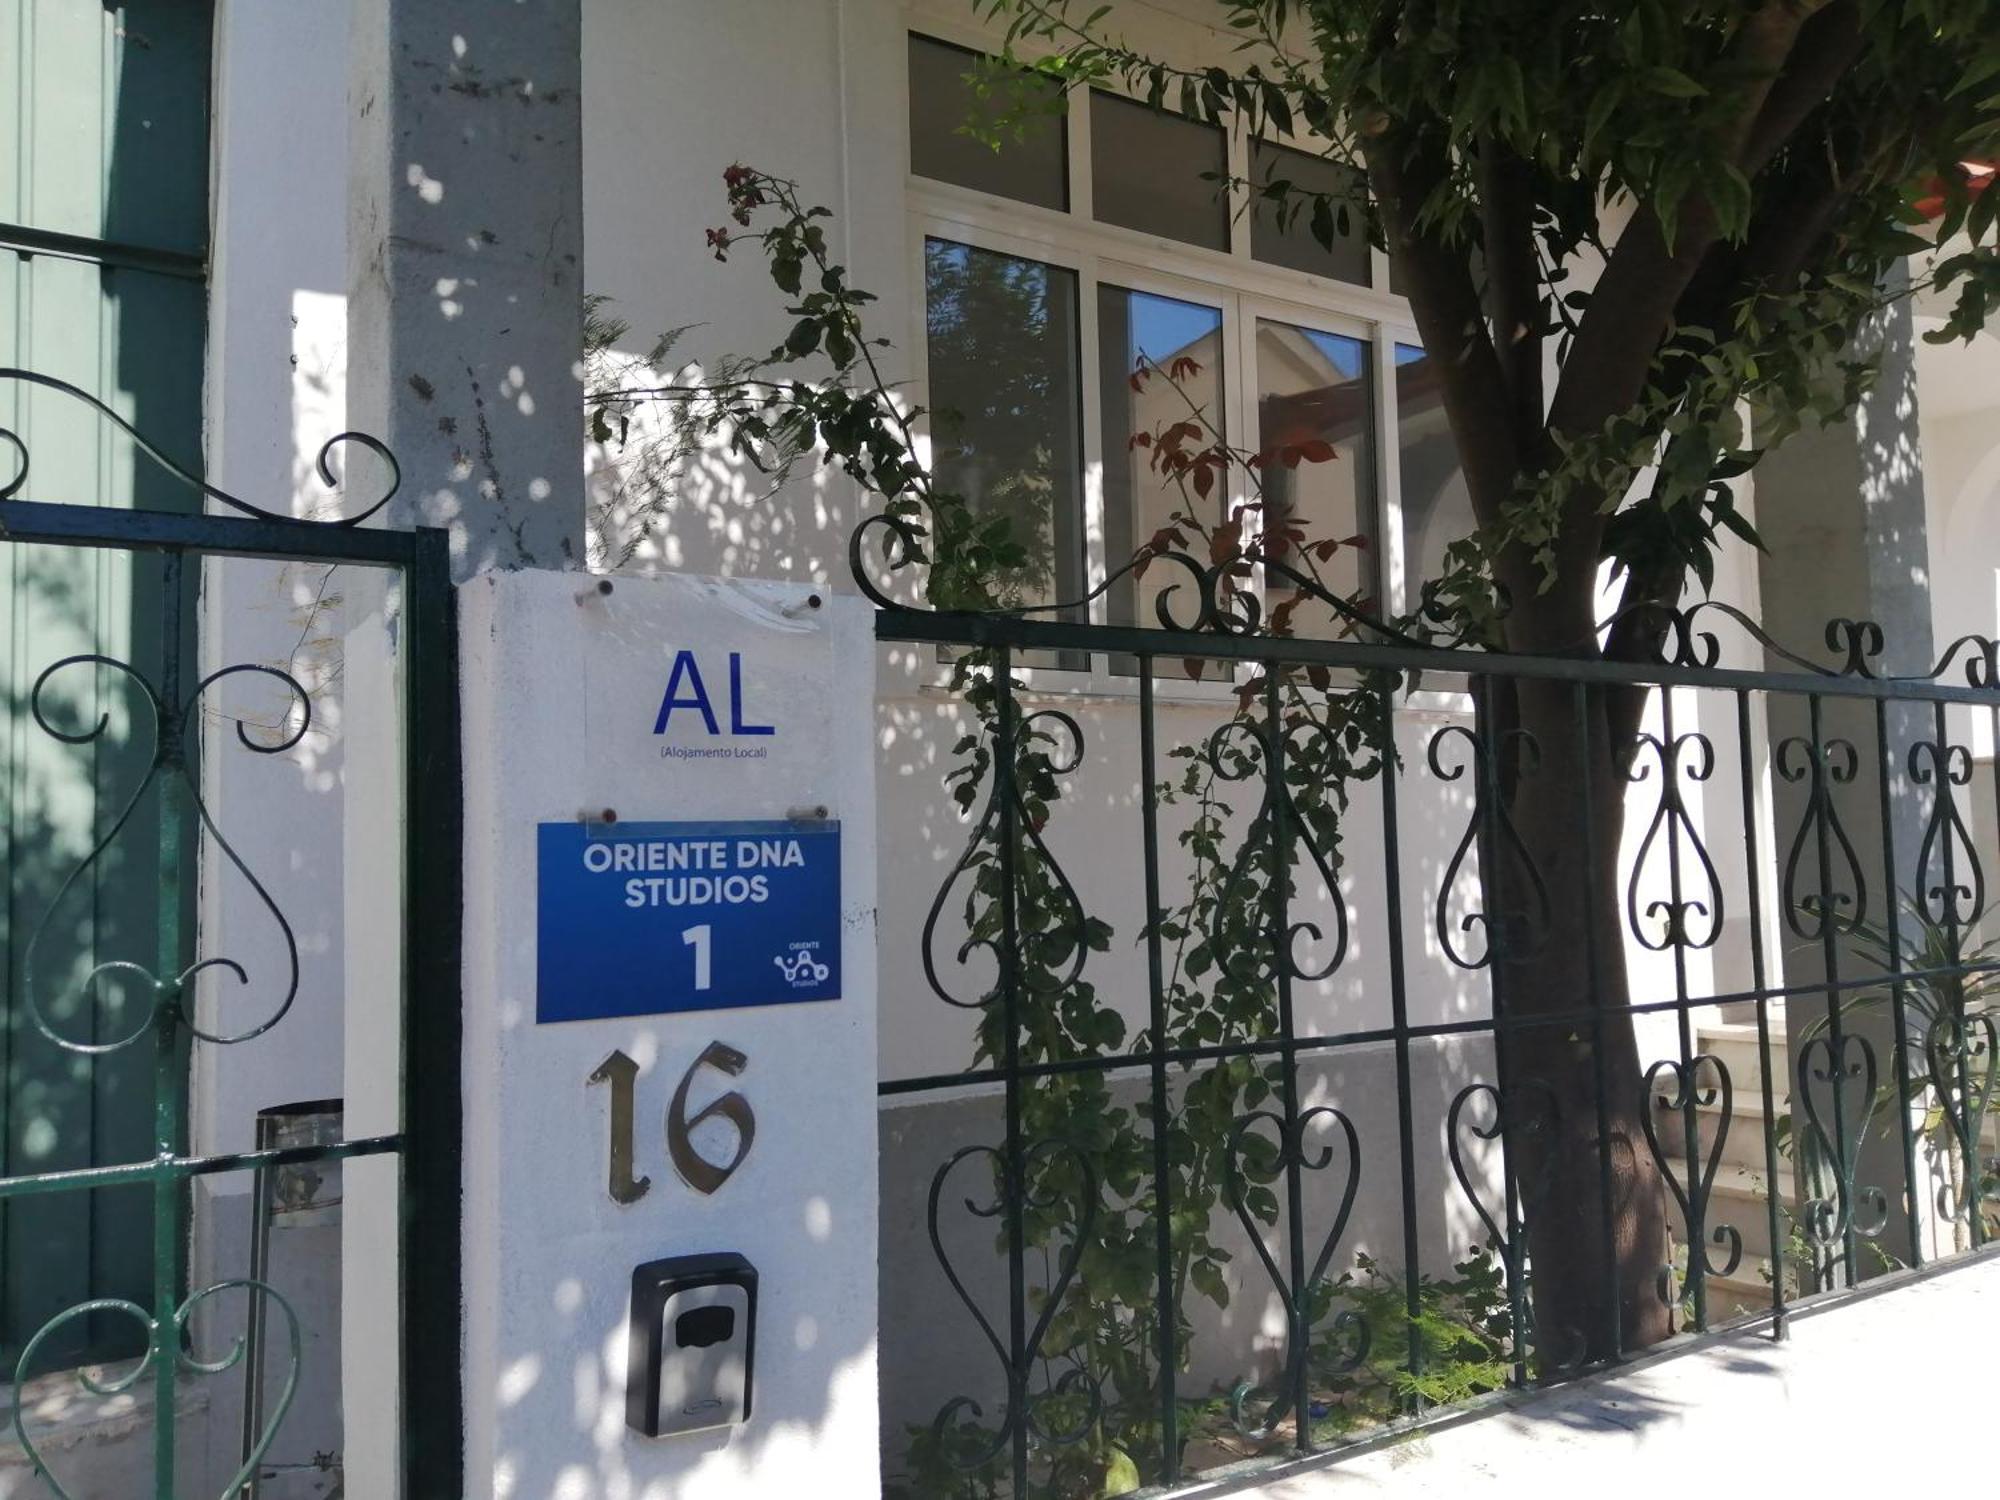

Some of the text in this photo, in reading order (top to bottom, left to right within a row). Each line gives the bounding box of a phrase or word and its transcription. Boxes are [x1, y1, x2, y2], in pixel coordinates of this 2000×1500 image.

[653, 650, 775, 735] AL
[660, 745, 768, 760] (Alojamento Local)
[583, 840, 805, 872] ORIENTE DNA
[625, 875, 769, 907] STUDIOS
[682, 925, 711, 990] 1
[586, 1040, 756, 1205] 16
